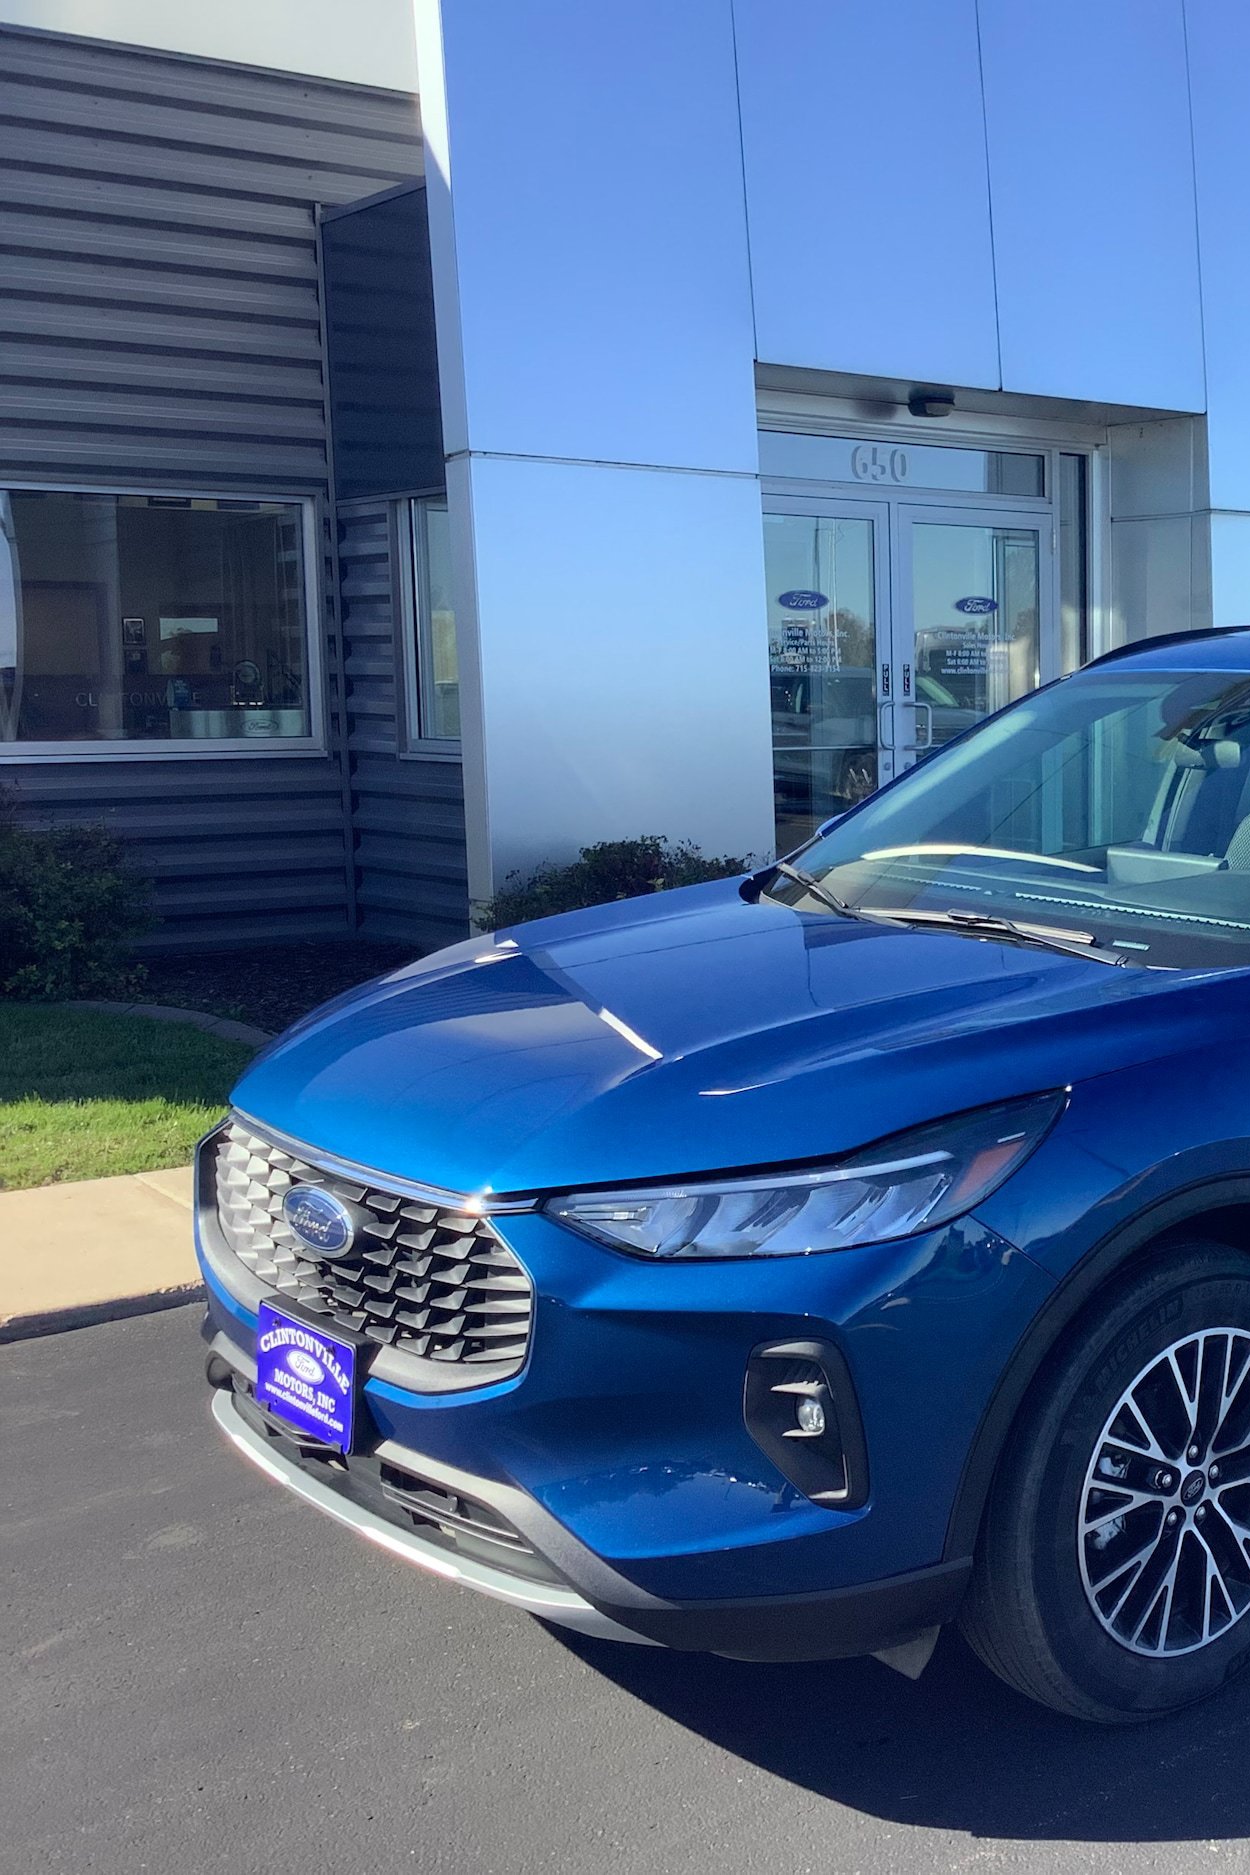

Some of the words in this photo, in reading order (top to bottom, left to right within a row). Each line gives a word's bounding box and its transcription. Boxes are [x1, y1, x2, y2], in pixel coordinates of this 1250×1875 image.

[851, 446, 907, 482] 650
[292, 1200, 332, 1234] Ford
[260, 1327, 350, 1395] CLINTONVILLE
[264, 1382, 344, 1433] www.clintonvilleford.com
[274, 1368, 316, 1406] MOTORS,
[317, 1391, 336, 1413] INC
